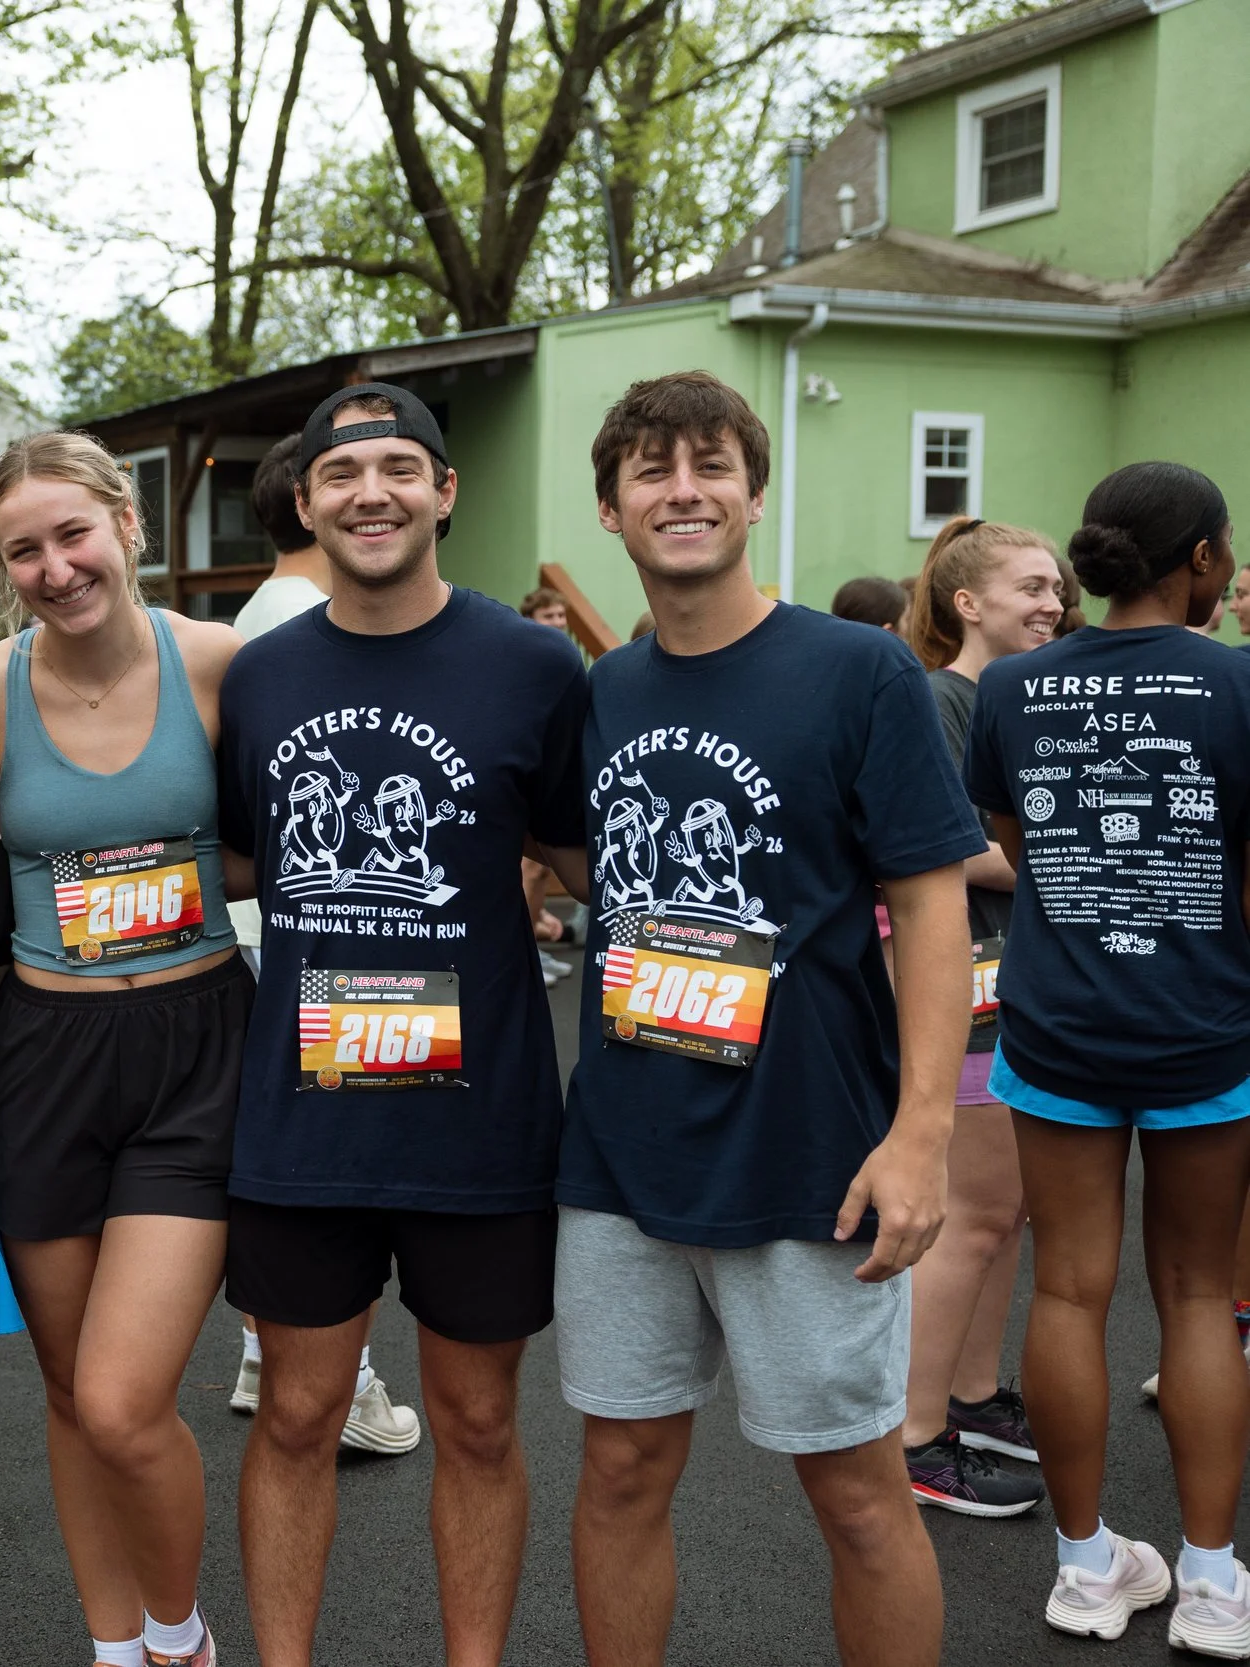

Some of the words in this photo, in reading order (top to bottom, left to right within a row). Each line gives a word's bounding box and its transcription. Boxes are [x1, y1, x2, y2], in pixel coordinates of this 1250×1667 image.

[1024, 676, 1124, 698] VERSE
[1023, 701, 1095, 714] CHOCOLATE
[1083, 712, 1156, 732] ASEA
[268, 706, 382, 781] POTTER'S
[389, 711, 476, 792] HOUSE
[1125, 737, 1192, 753] emmaus
[590, 726, 690, 811] POTTER'S
[694, 731, 781, 816] HOUSE
[1080, 764, 1123, 782] Ridgeview
[458, 810, 477, 825] 26
[1043, 827, 1078, 837] STEVENS
[1119, 833, 1139, 841] WIND
[1157, 835, 1182, 844] FRANK
[1184, 837, 1191, 845] &
[98, 841, 165, 862] HEARTLAND
[765, 836, 784, 854] 26
[1043, 847, 1061, 855] BANK
[1132, 849, 1164, 857] ORCHARD
[1089, 857, 1123, 865] NAZARENE
[1184, 852, 1223, 861] MASSEYCO
[1064, 875, 1080, 883] FIRM
[1116, 868, 1168, 877] NEIGHBORHOOD
[1169, 870, 1201, 879] WALMART
[1171, 881, 1210, 890] MONUMENT
[1211, 883, 1223, 891] CO
[87, 874, 184, 935] 2046
[300, 902, 324, 915] STEVE
[326, 904, 378, 917] PROFFITT
[380, 906, 424, 920] LEGACY
[270, 912, 295, 930] 4TH
[297, 915, 353, 934] ANNUAL
[356, 920, 377, 936] 5K
[381, 921, 394, 937] &
[398, 922, 431, 939] FUN
[436, 922, 467, 940] RUN
[659, 923, 737, 945] HEARTLAND
[352, 976, 426, 988] HEARTLAND
[627, 961, 747, 1029] 2062
[334, 1013, 436, 1064] 2168
